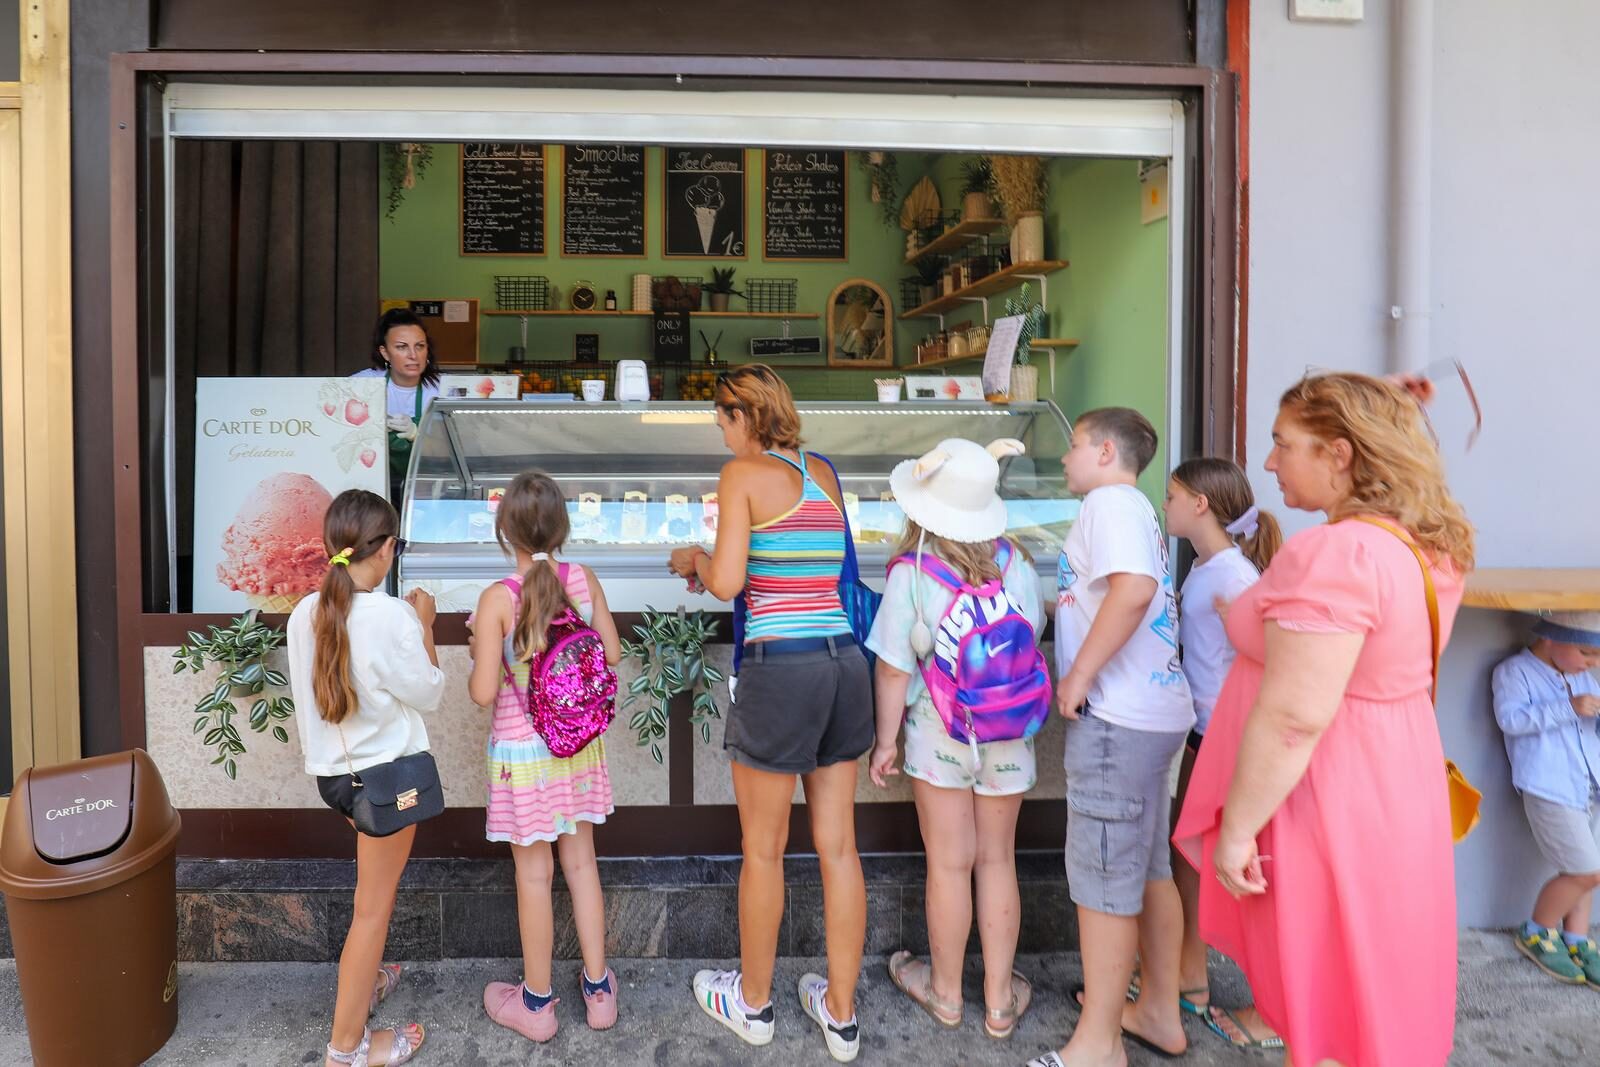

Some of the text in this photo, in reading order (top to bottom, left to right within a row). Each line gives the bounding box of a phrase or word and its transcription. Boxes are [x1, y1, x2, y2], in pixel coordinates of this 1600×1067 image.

[574, 144, 640, 163] Smoothies
[770, 153, 839, 172] Protein Shakes
[656, 319, 681, 330] ONLY
[659, 335, 684, 345] CASH
[203, 418, 321, 438] CARTE D'OR
[228, 443, 297, 462] Gelateria
[45, 799, 119, 821] CARTE D'OR
